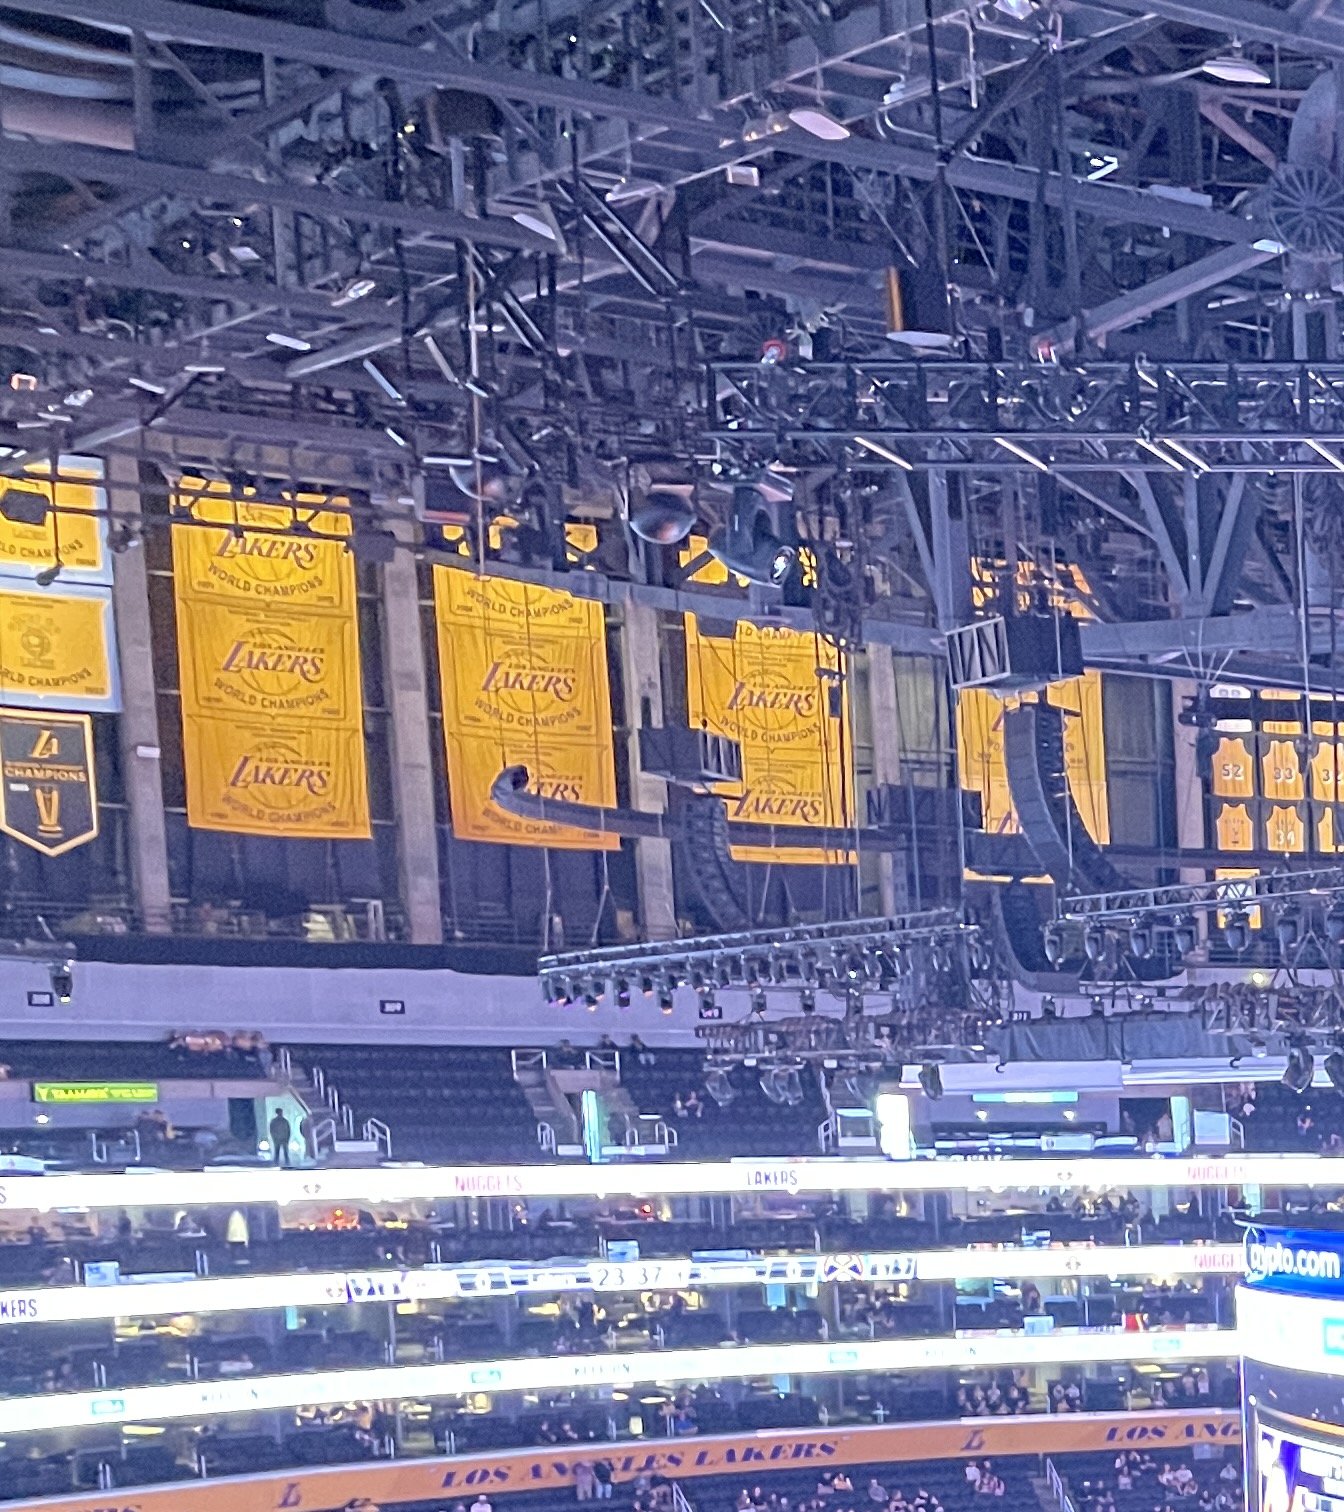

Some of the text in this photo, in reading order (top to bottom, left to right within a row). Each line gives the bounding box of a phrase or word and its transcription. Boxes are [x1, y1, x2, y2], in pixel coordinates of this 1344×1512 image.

[216, 532, 319, 571] LAKERS
[208, 561, 323, 597] WORLD CHAMPIONS
[222, 640, 324, 684] LAKERS
[214, 677, 329, 710] WORLD CHAMPIONS
[481, 661, 577, 703] LAKERS
[727, 680, 817, 718] LAKERS
[4, 766, 87, 782] CHAMPIONS
[230, 755, 331, 797] LAKERS
[1221, 762, 1245, 781] 52
[1273, 767, 1297, 784] 33
[733, 788, 824, 824] LAKERS
[454, 1173, 524, 1193] NUGGETS
[746, 1169, 798, 1188] LAKERS
[1187, 1164, 1247, 1182] NUGGETS
[1105, 1424, 1168, 1442] LOS
[441, 1465, 510, 1489] LOS
[694, 1440, 839, 1467] LAKERS
